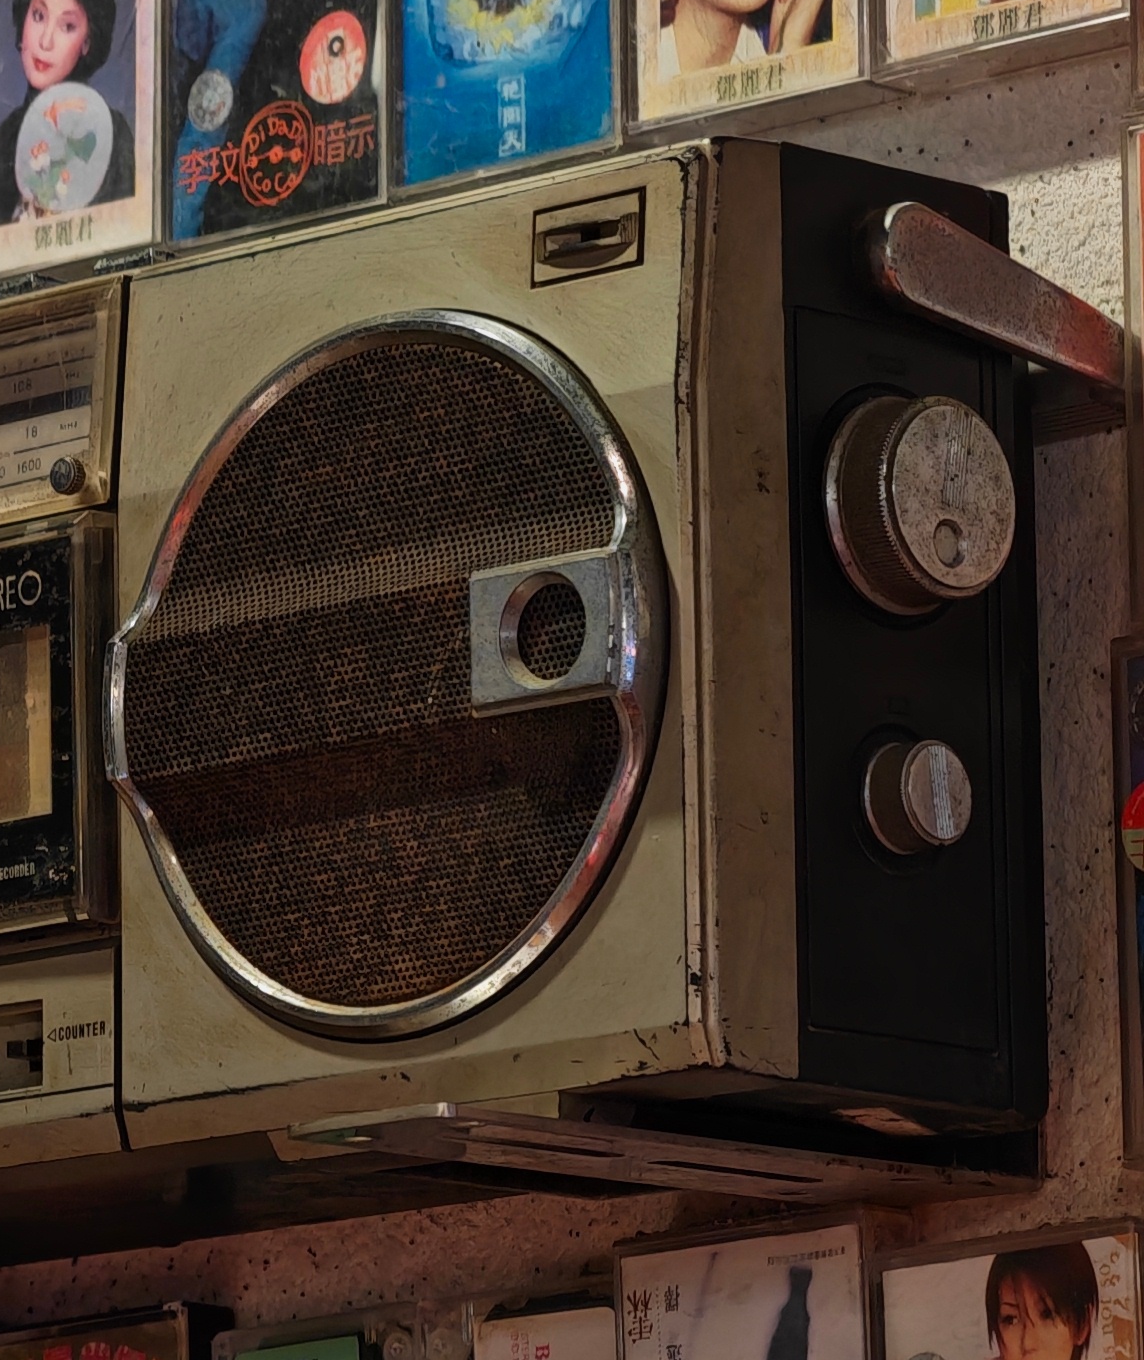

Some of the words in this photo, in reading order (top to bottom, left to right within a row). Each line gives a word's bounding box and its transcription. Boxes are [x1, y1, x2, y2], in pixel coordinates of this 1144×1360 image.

[178, 140, 240, 194] 李玟
[313, 113, 375, 166] 暗示
[25, 425, 38, 439] 18
[16, 457, 42, 475] 1600
[57, 1020, 107, 1042] COUNTER
[534, 1343, 551, 1360] B
